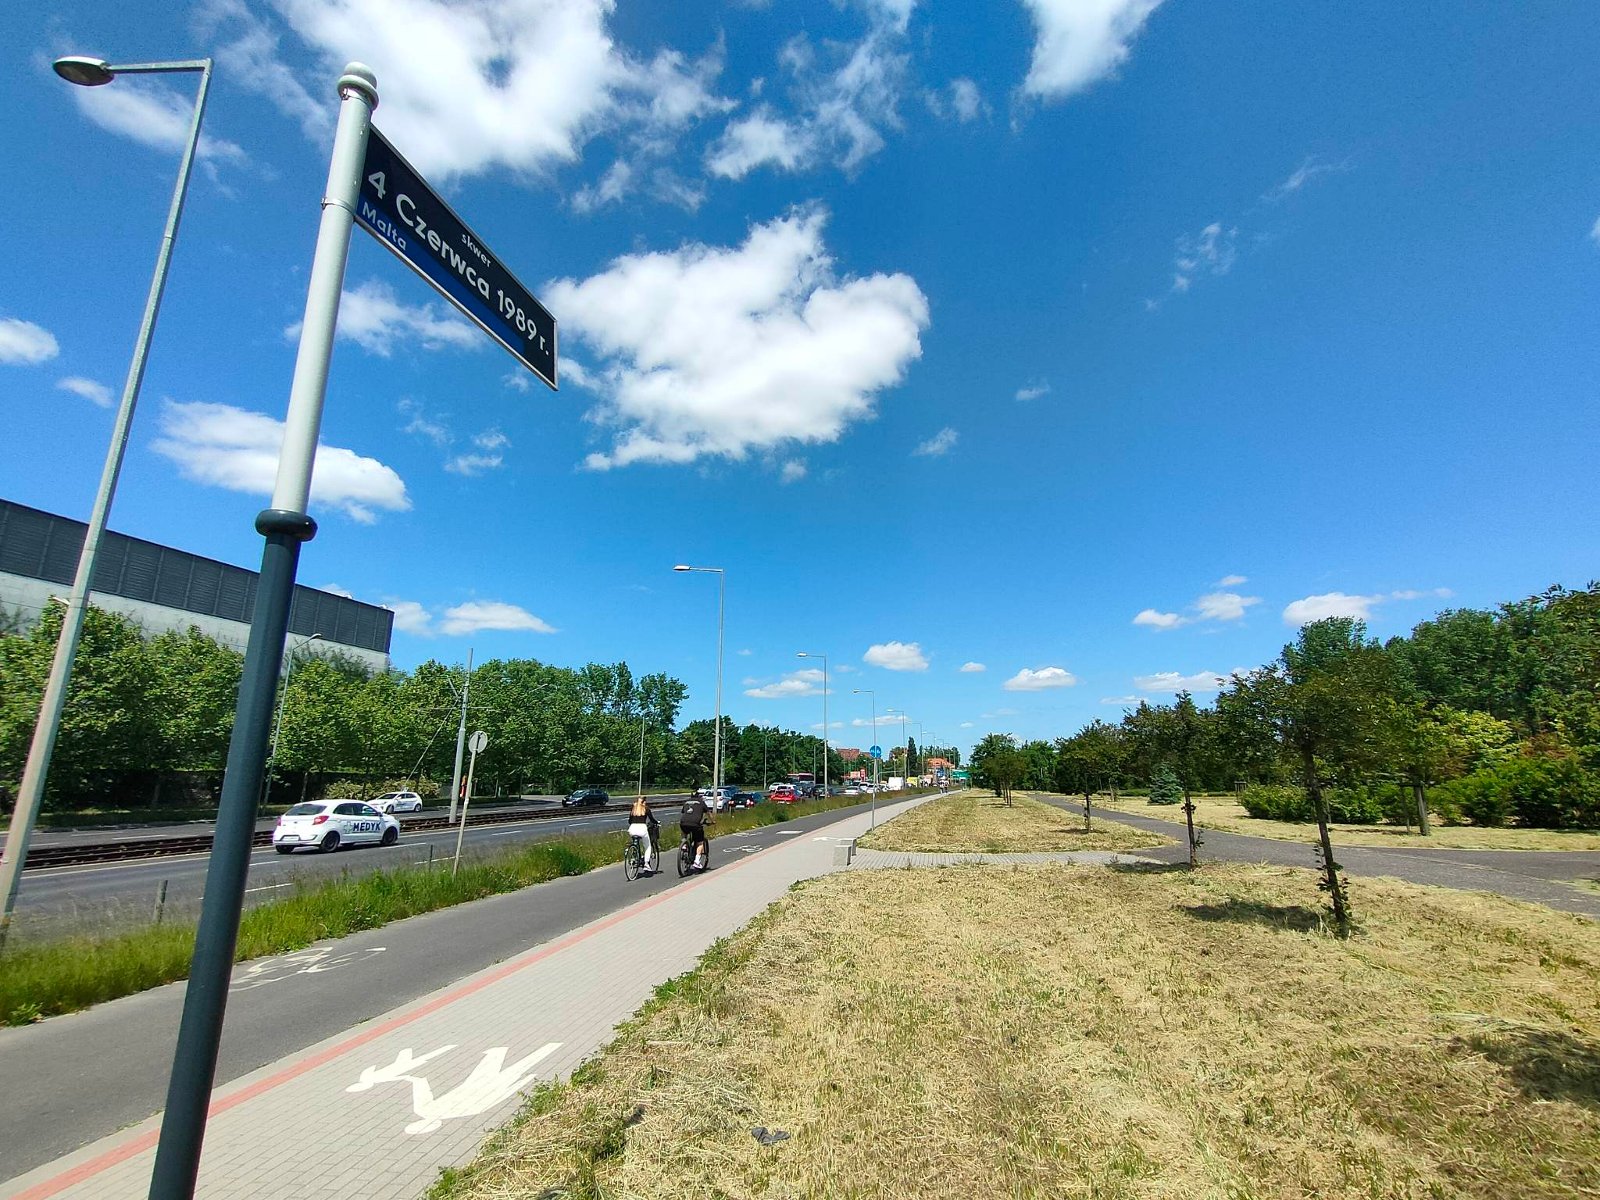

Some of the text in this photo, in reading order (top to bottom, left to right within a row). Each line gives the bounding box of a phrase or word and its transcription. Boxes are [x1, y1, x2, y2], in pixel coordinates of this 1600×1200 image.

[362, 201, 407, 250] Malta
[368, 171, 549, 355] 4 Czerwca 1989 r.
[461, 233, 491, 268] skwer
[353, 822, 381, 832] MEDYK
